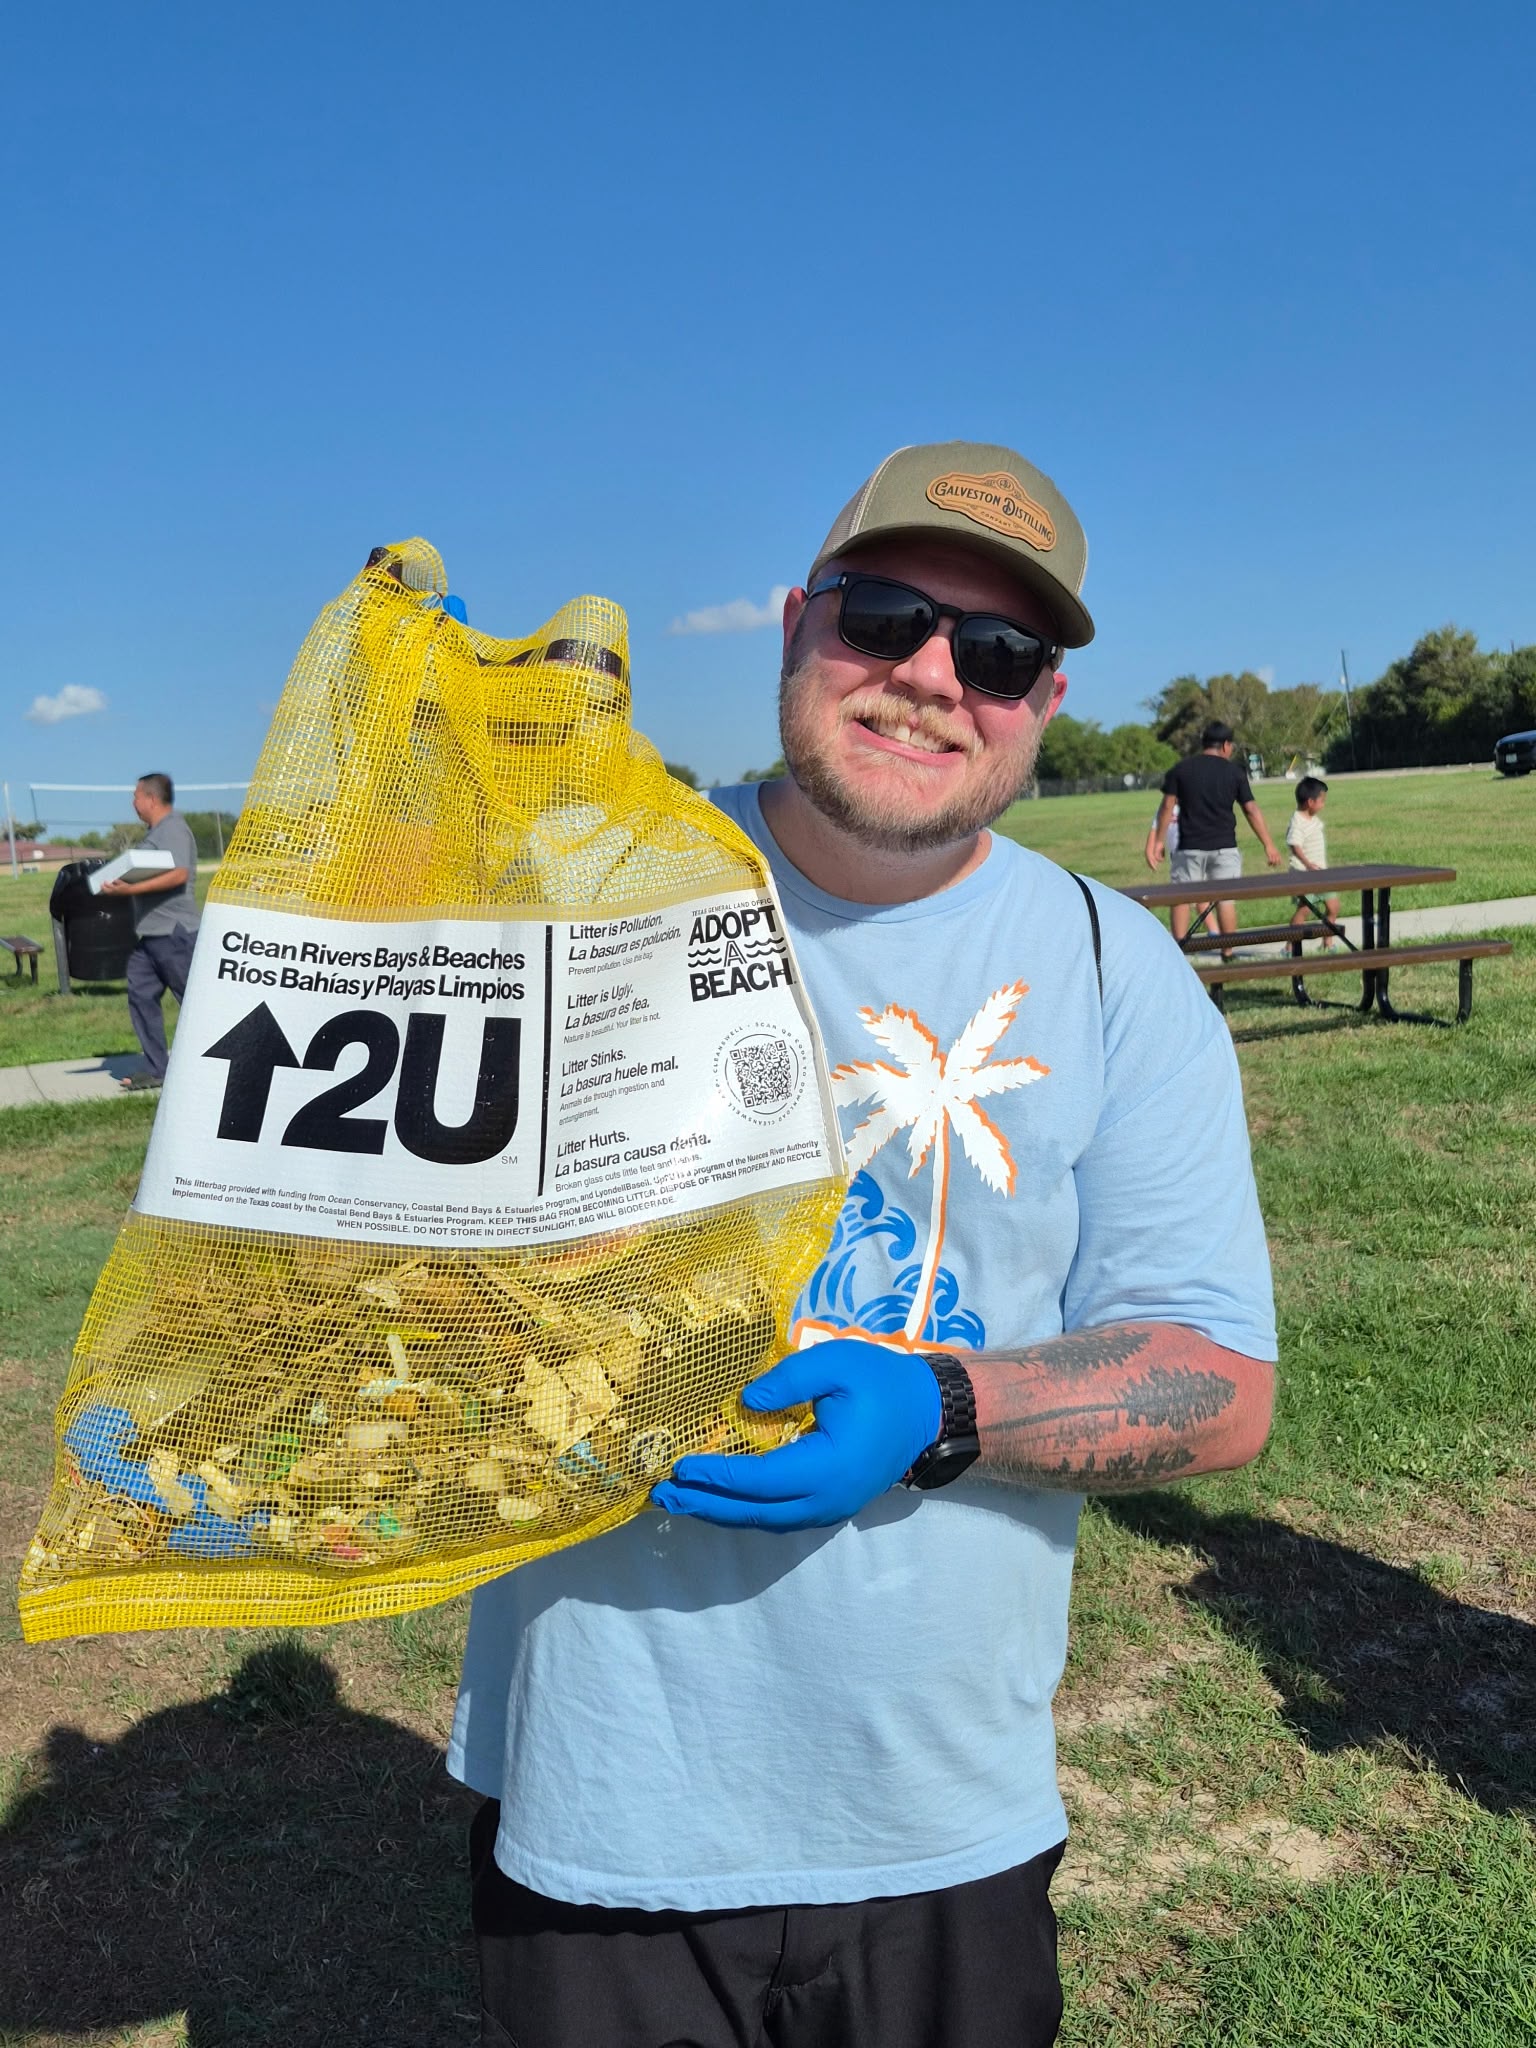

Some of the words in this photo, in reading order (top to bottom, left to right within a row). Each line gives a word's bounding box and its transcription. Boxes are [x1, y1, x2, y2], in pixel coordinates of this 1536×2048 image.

[935, 482, 1001, 506] GALVESTON
[1002, 497, 1052, 541] DISTILLING
[980, 511, 1012, 528] COMPANY
[688, 905, 776, 946] ADOPT
[692, 908, 707, 916] TEXAS
[708, 904, 732, 913] GENERAL
[569, 946, 586, 960] La
[590, 942, 628, 959] basura
[630, 941, 640, 951] es
[641, 926, 681, 950] polución.
[570, 925, 607, 939] Litter
[608, 923, 618, 936] is
[620, 915, 663, 934] Pollution.
[222, 931, 297, 960] Clean
[300, 942, 372, 967] Rivers
[373, 947, 418, 972] Bays
[419, 945, 430, 967] &
[432, 945, 525, 970] Beaches
[568, 965, 596, 975] Prevent
[597, 961, 621, 974] pollution.
[622, 957, 633, 966] Use
[634, 954, 642, 963] this
[723, 940, 747, 967] A
[217, 958, 277, 986] Ríos
[280, 967, 360, 996] Bahías
[361, 980, 375, 1000] y
[375, 975, 436, 1001] Playas
[438, 974, 525, 1004] Limpios
[568, 994, 598, 1009] Litter
[600, 989, 609, 1003] is
[611, 983, 634, 1001] Ugly.
[563, 1032, 584, 1044] Nature
[585, 1030, 590, 1039] is
[616, 1019, 628, 1029] Your
[629, 1016, 642, 1026] litter
[642, 1014, 648, 1022] is
[649, 1011, 661, 1021] not.
[565, 1016, 580, 1030] La
[582, 1007, 616, 1027] basura
[618, 1003, 630, 1015] es
[631, 997, 650, 1012] fea.
[755, 1022, 777, 1030] SCAN
[782, 1029, 792, 1037] QR
[795, 1039, 806, 1060] CODE
[560, 1083, 574, 1098] La
[576, 1072, 612, 1092] basura
[614, 1062, 648, 1081] huele
[651, 1056, 679, 1074] mal.
[562, 1060, 589, 1077] Litter
[590, 1048, 626, 1068] Stinks.
[802, 1066, 807, 1077] TO
[280, 1010, 521, 1165] 2U
[560, 1098, 582, 1112] Animals
[594, 1088, 617, 1101] through
[618, 1082, 649, 1096] ingestion
[650, 1078, 665, 1088] and
[778, 1082, 805, 1122] DOWNLOAD
[559, 1107, 600, 1125] entanglement.
[501, 1155, 518, 1164] SM
[555, 1163, 570, 1178] La
[573, 1153, 620, 1174] basura
[624, 1142, 666, 1162] causa
[556, 1138, 586, 1158] Litter
[589, 1130, 630, 1149] Hurts.
[172, 1188, 223, 1202] Implemented
[225, 1195, 234, 1203] on
[236, 1196, 247, 1205] the
[249, 1198, 269, 1207] Texas
[271, 1201, 292, 1210] coast
[293, 1203, 303, 1212] by
[305, 1204, 316, 1212] the
[318, 1205, 347, 1216] Coastal
[350, 1209, 370, 1218] Bend
[373, 1212, 393, 1221] Bays
[404, 1214, 444, 1223] Estuaries
[446, 1217, 486, 1226] Program.
[516, 1216, 537, 1224] THIS
[539, 1212, 557, 1222] BAG
[559, 1205, 581, 1218] FROM
[583, 1196, 624, 1213] BECOMING
[626, 1189, 658, 1202] LITTER.
[660, 1179, 697, 1194] DISPOSE
[698, 1177, 710, 1185] OF
[712, 1169, 737, 1182] TRASH
[738, 1162, 770, 1176] PROPERLY
[771, 1157, 786, 1167] AND
[786, 1150, 822, 1163] RECYCLE
[175, 1177, 192, 1186] This
[194, 1179, 227, 1191] litterbag
[228, 1185, 260, 1195] provided
[261, 1187, 276, 1196] with
[278, 1189, 307, 1200] funding
[309, 1193, 326, 1201] from
[328, 1195, 352, 1205] Ocean
[354, 1198, 409, 1211] Conservancy,
[411, 1202, 444, 1212] Coastal
[446, 1205, 469, 1213] Bend
[472, 1206, 492, 1215] Bays
[504, 1205, 543, 1214] Estuaries
[545, 1197, 579, 1209] Program,
[580, 1192, 593, 1201] and
[694, 1163, 725, 1176] program
[727, 1159, 734, 1168] of
[735, 1157, 746, 1166] the
[747, 1151, 769, 1163] Nueces
[770, 1147, 785, 1157] River
[787, 1140, 819, 1153] Authority
[556, 1180, 583, 1193] Broken
[584, 1176, 604, 1189] glass
[605, 1171, 622, 1181] cuts
[622, 1167, 638, 1177] little
[639, 1164, 655, 1173] feet
[656, 1158, 673, 1169] and
[336, 1219, 362, 1229] WHEN
[364, 1222, 411, 1233] POSSIBLE.
[413, 1225, 427, 1234] DO
[429, 1227, 448, 1235] NOT
[450, 1228, 482, 1236] STORE
[485, 1228, 494, 1236] IN
[496, 1227, 531, 1236] DIRECT
[532, 1219, 577, 1233] SUNLIGHT,
[578, 1214, 595, 1225] BAG
[596, 1209, 616, 1221] WILL
[618, 1196, 678, 1216] BIODEGRADE.
